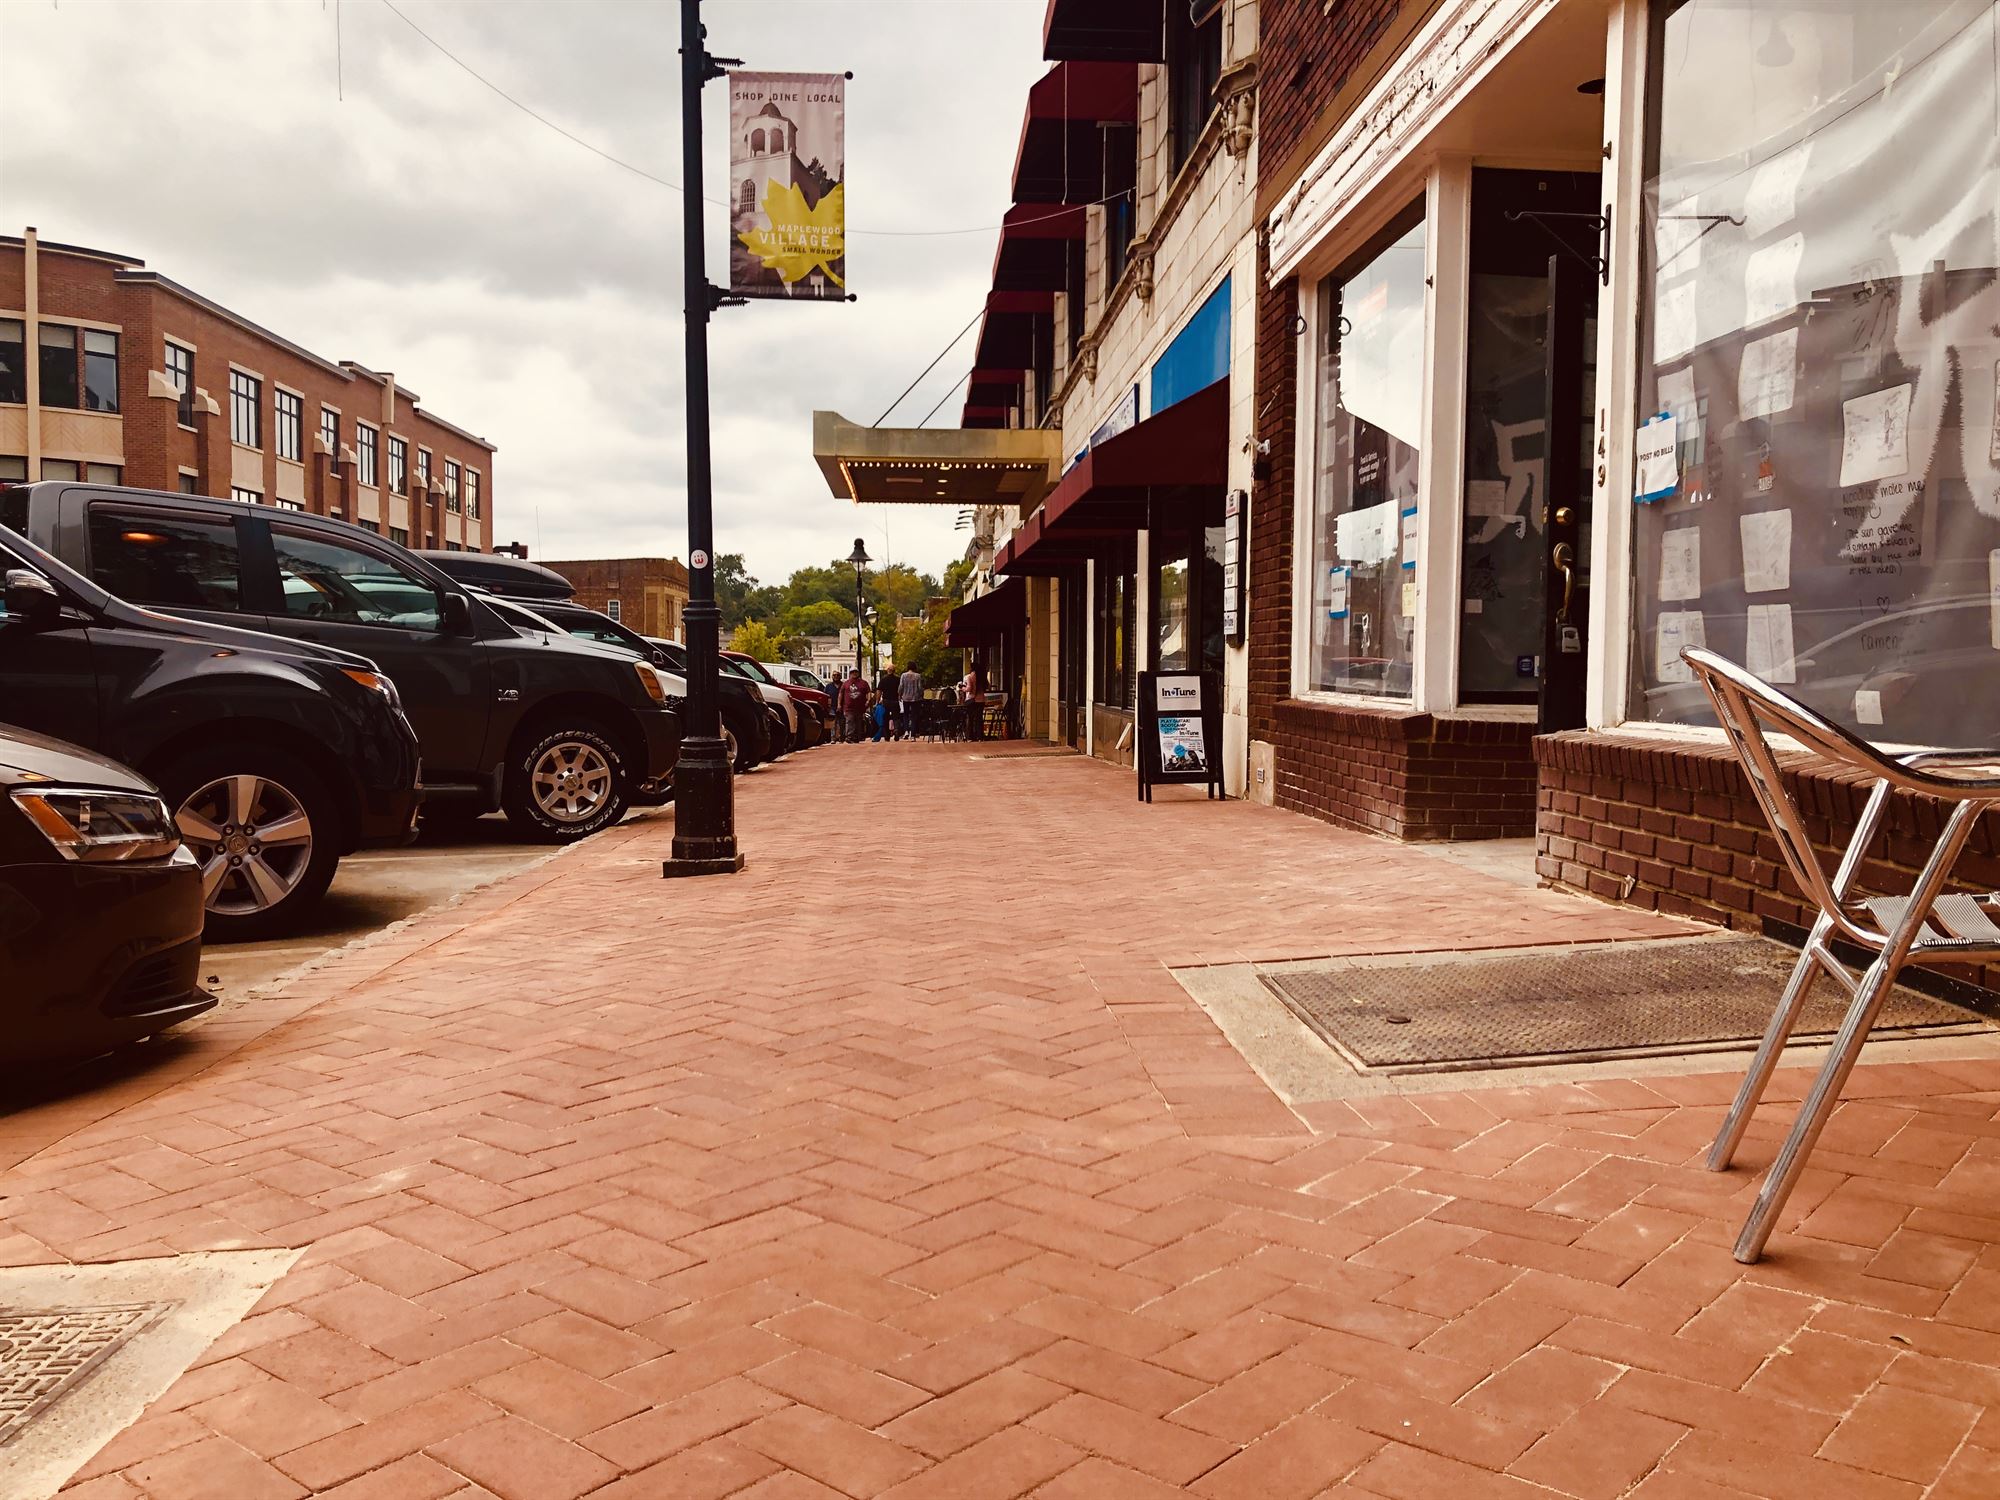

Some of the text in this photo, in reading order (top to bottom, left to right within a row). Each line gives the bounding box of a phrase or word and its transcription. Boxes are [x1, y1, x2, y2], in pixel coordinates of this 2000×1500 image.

[735, 92, 841, 103] SHOP DINE LOCAL
[777, 224, 840, 234] MAPLEWOOD
[760, 232, 830, 247] VILLAGE
[809, 247, 841, 255] WONDER
[1598, 408, 1606, 488] 149
[1640, 445, 1674, 461] POST NO BILLS
